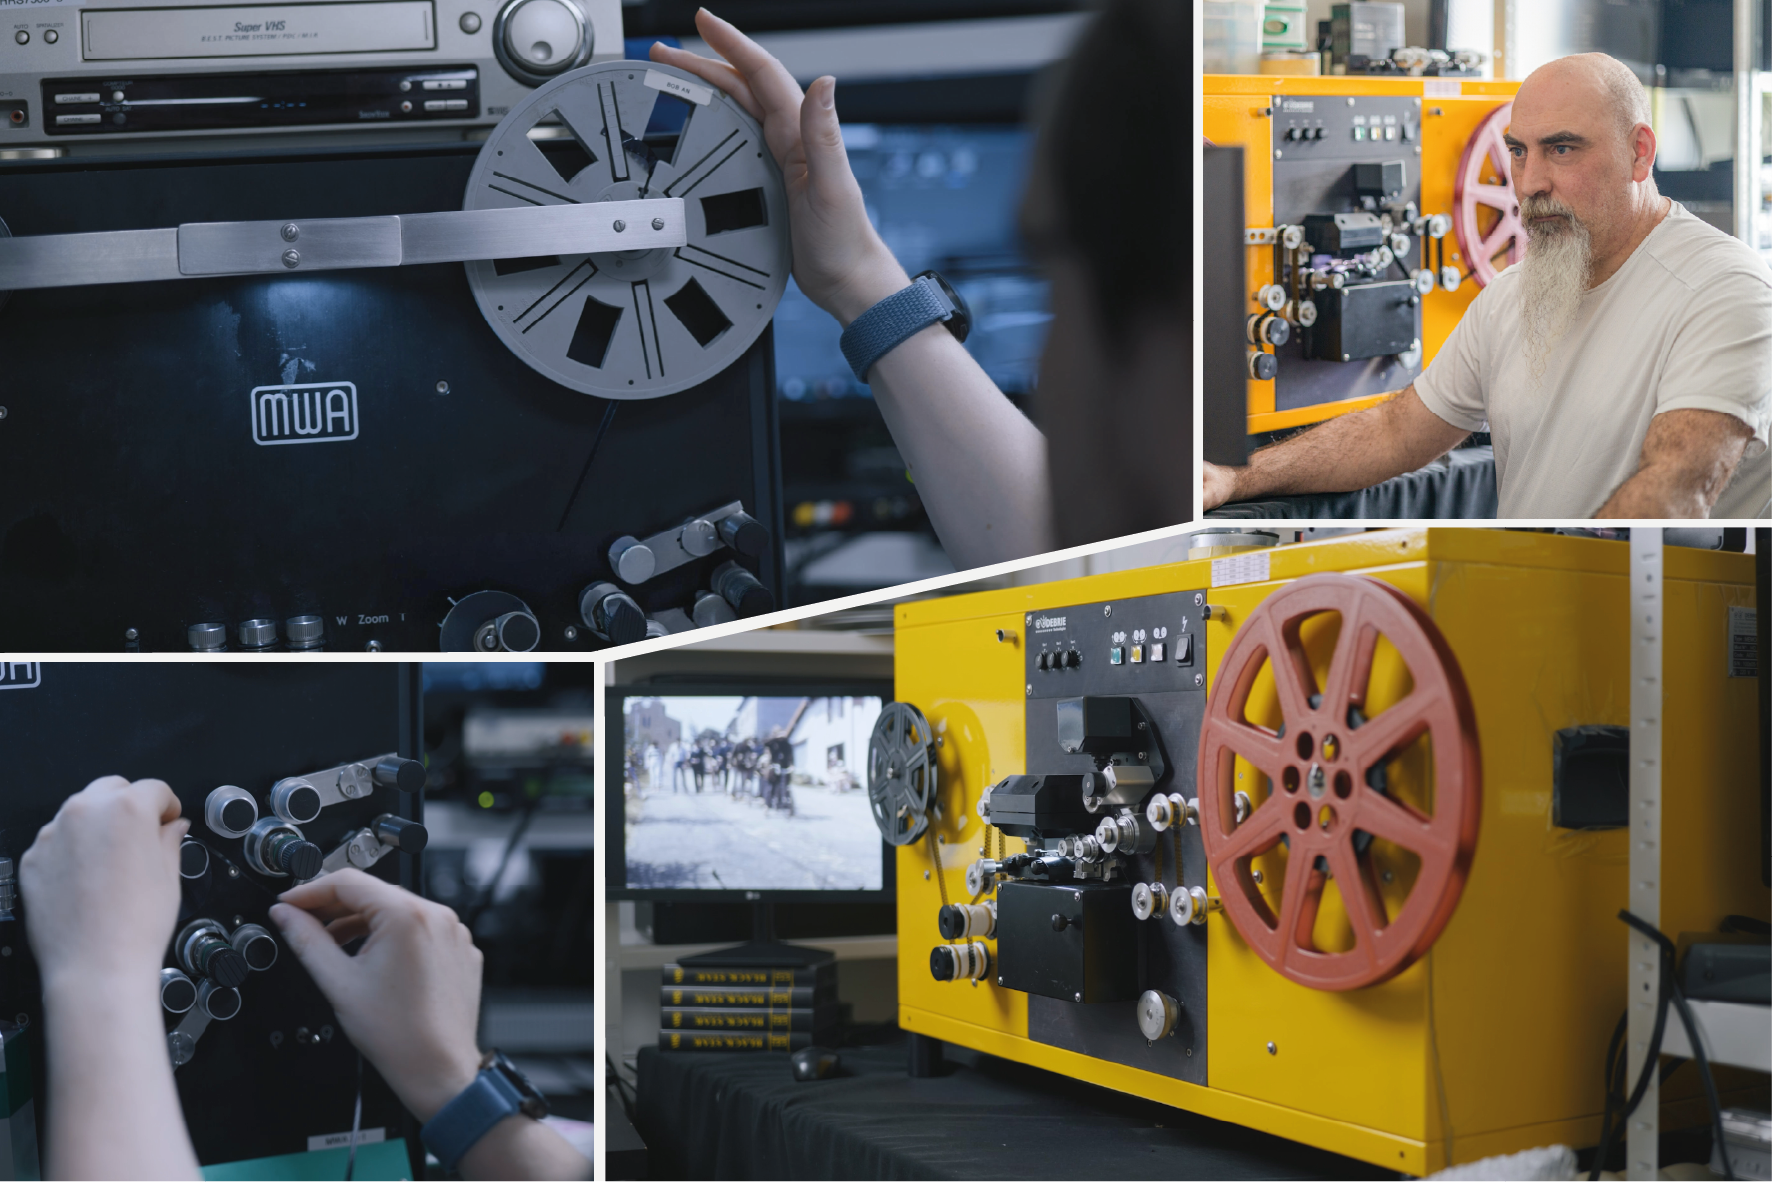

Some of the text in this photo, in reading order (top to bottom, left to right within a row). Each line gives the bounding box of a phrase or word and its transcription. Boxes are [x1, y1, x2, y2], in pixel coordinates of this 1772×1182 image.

[233, 20, 286, 33] Super VHS
[666, 81, 680, 90] BOB
[260, 389, 351, 437] MWA
[335, 616, 348, 626] W
[357, 614, 389, 625] Zoom
[1046, 617, 1066, 628] DEBRIE
